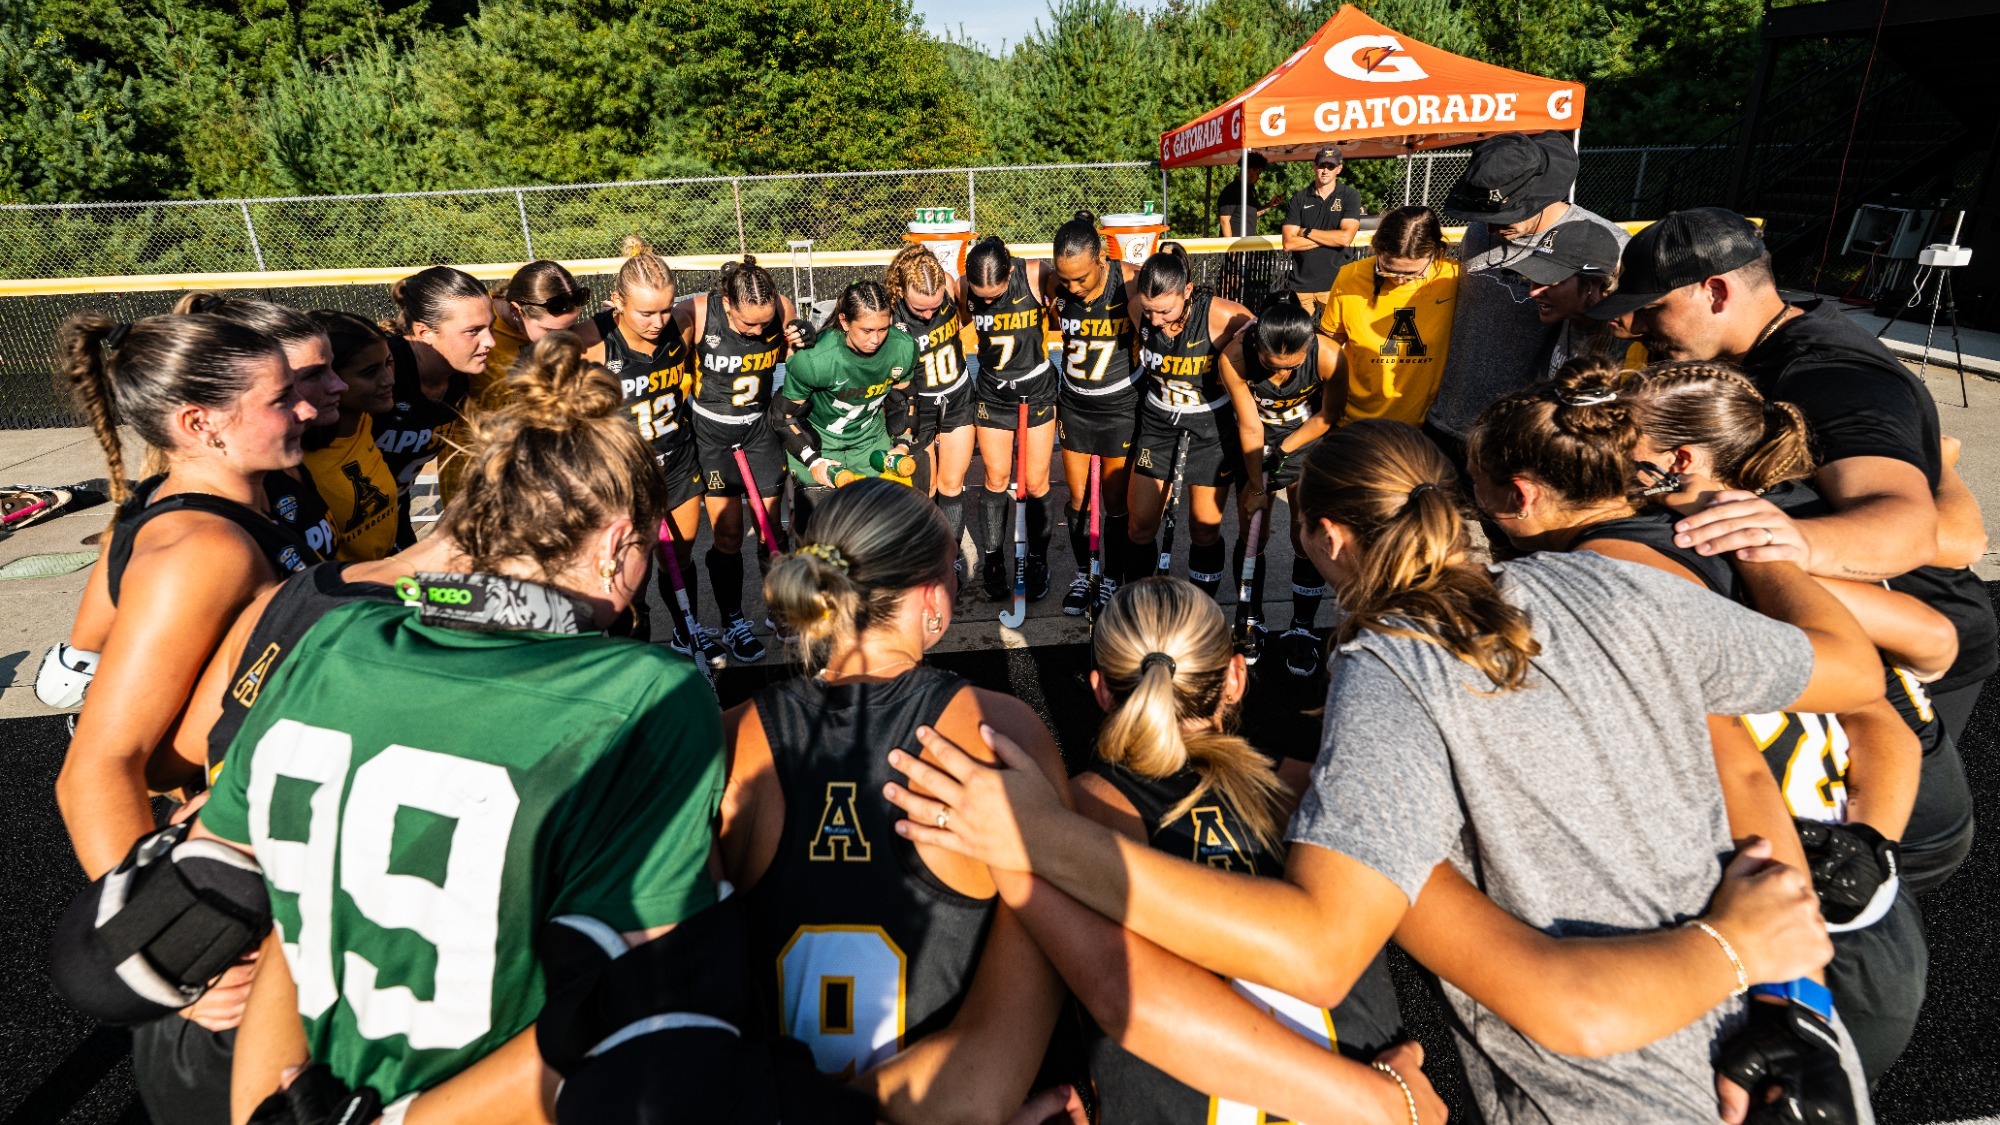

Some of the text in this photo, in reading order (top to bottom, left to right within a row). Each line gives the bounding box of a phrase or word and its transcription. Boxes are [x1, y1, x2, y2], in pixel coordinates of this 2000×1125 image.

[1324, 34, 1430, 83] G
[1173, 115, 1224, 158] GATORADE
[1231, 109, 1241, 140] G
[1260, 90, 1573, 137] G GATORADE G
[989, 335, 1016, 371] 7
[1380, 307, 1427, 356] A
[621, 362, 685, 399] PPSTAT
[704, 347, 781, 374] APPSTAT
[919, 344, 959, 388] 10
[1066, 339, 1117, 381] 27
[732, 375, 760, 408] 2
[630, 391, 679, 442] 12
[707, 470, 726, 489] A
[232, 642, 281, 708] A
[809, 781, 871, 861] A
[1191, 806, 1256, 877] A
[247, 718, 520, 1051] 99
